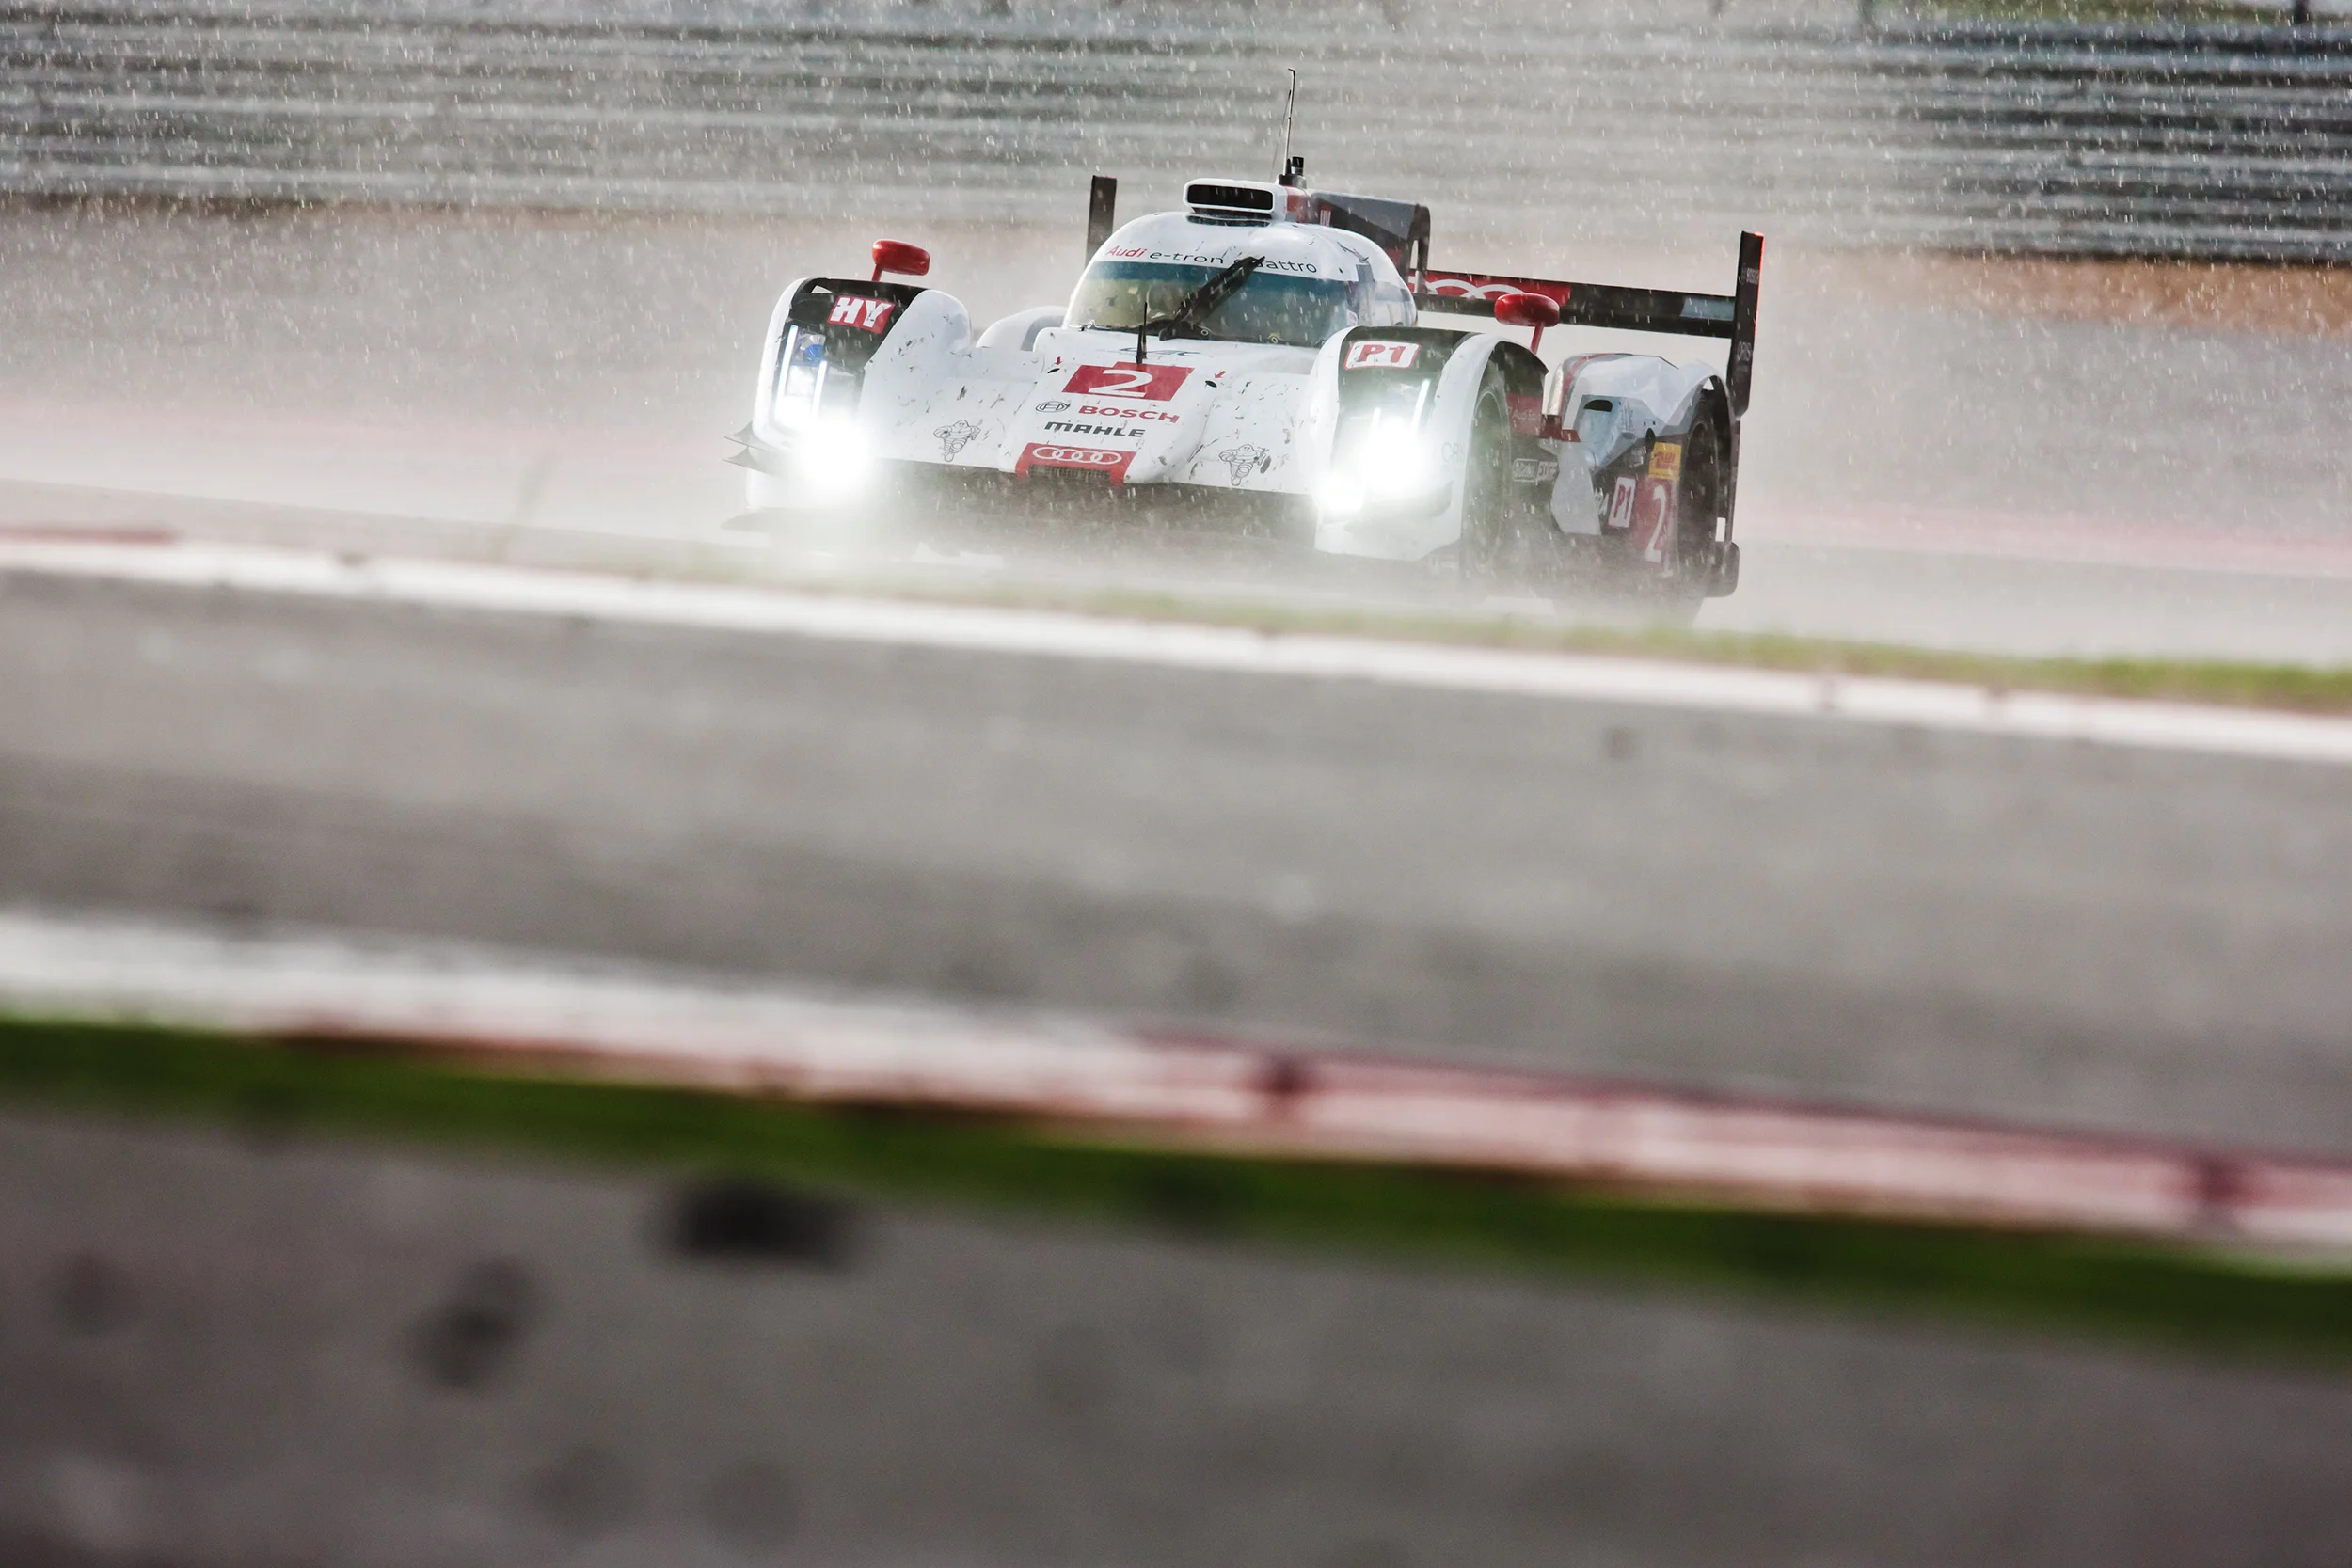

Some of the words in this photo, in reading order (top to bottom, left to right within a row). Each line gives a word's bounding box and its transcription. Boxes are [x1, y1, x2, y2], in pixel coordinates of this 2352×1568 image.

[1106, 245, 1147, 257] Audi
[1150, 252, 1223, 264] e-tron
[830, 296, 892, 327] HY
[1357, 344, 1406, 363] P1
[1088, 369, 1153, 398] 2
[1078, 405, 1180, 423] BOSCH
[1044, 421, 1146, 437] MAHLE
[1613, 484, 1632, 520] P1
[1645, 484, 1667, 563] 2
